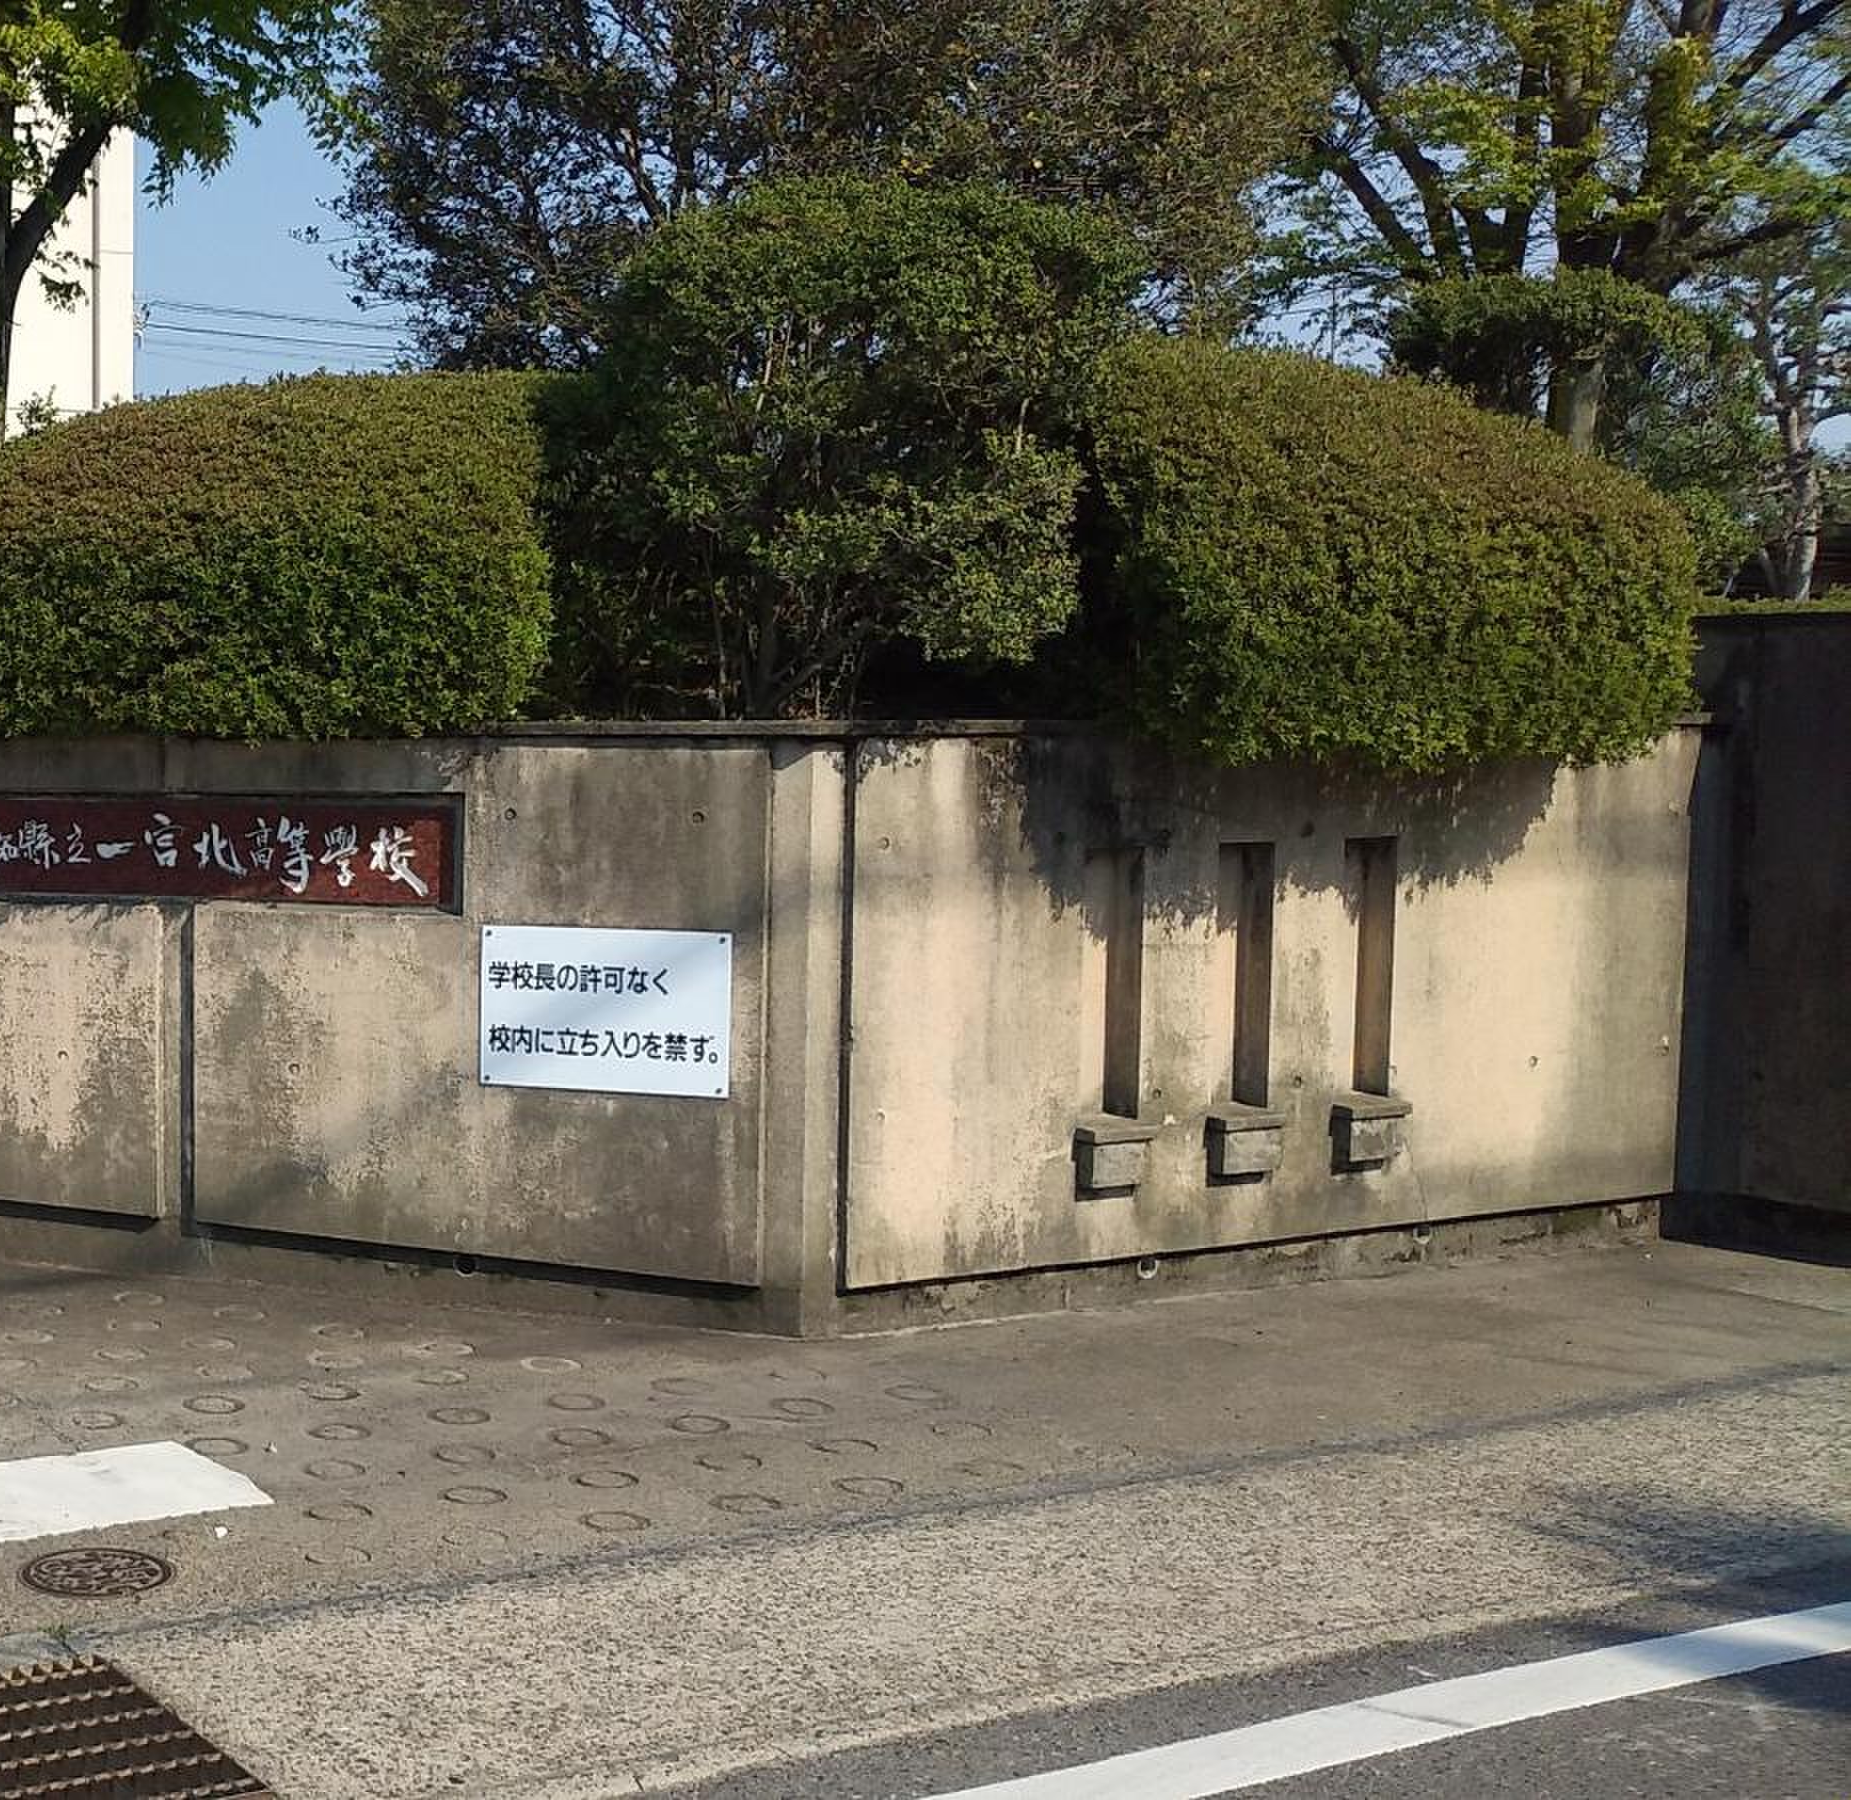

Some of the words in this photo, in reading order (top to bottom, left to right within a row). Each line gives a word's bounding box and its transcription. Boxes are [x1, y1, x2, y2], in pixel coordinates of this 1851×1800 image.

[488, 960, 669, 996] 学校長の許可なく
[488, 1023, 719, 1064] 校内に立ち入りを禁ず。
